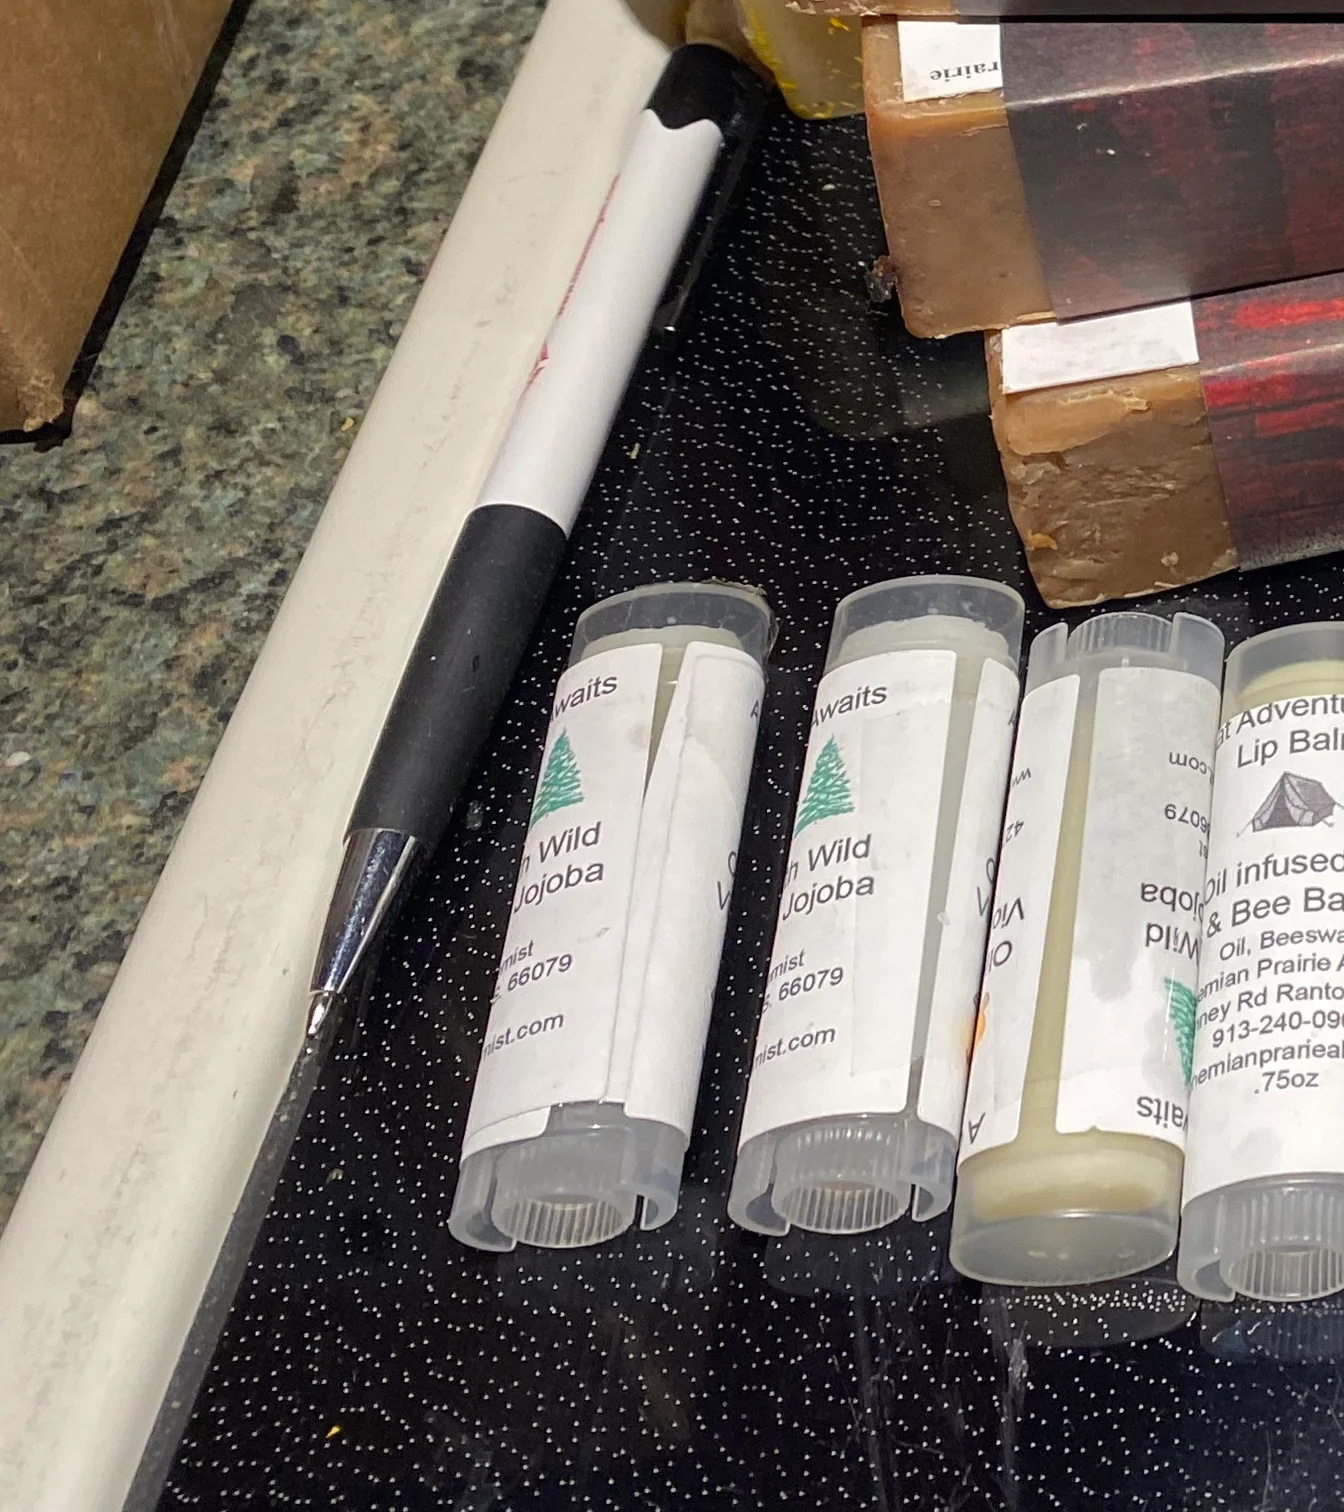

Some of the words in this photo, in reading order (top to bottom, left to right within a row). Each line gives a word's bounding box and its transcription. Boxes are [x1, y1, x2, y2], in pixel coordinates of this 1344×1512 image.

[1237, 738, 1279, 769] Lip
[538, 820, 602, 863] Wild
[807, 833, 873, 872] Wild
[513, 861, 605, 914] Jojoba
[782, 875, 875, 921] Jojoba
[1206, 911, 1222, 938] &
[1231, 893, 1291, 928] Bee
[1145, 922, 1200, 966] Wild
[1219, 936, 1252, 962] Oil,
[507, 952, 573, 992] 66079
[778, 966, 844, 1001] 66079
[1256, 952, 1332, 980] Prairie
[1237, 987, 1268, 1013] Rd
[1253, 1069, 1320, 1095] .75oz
